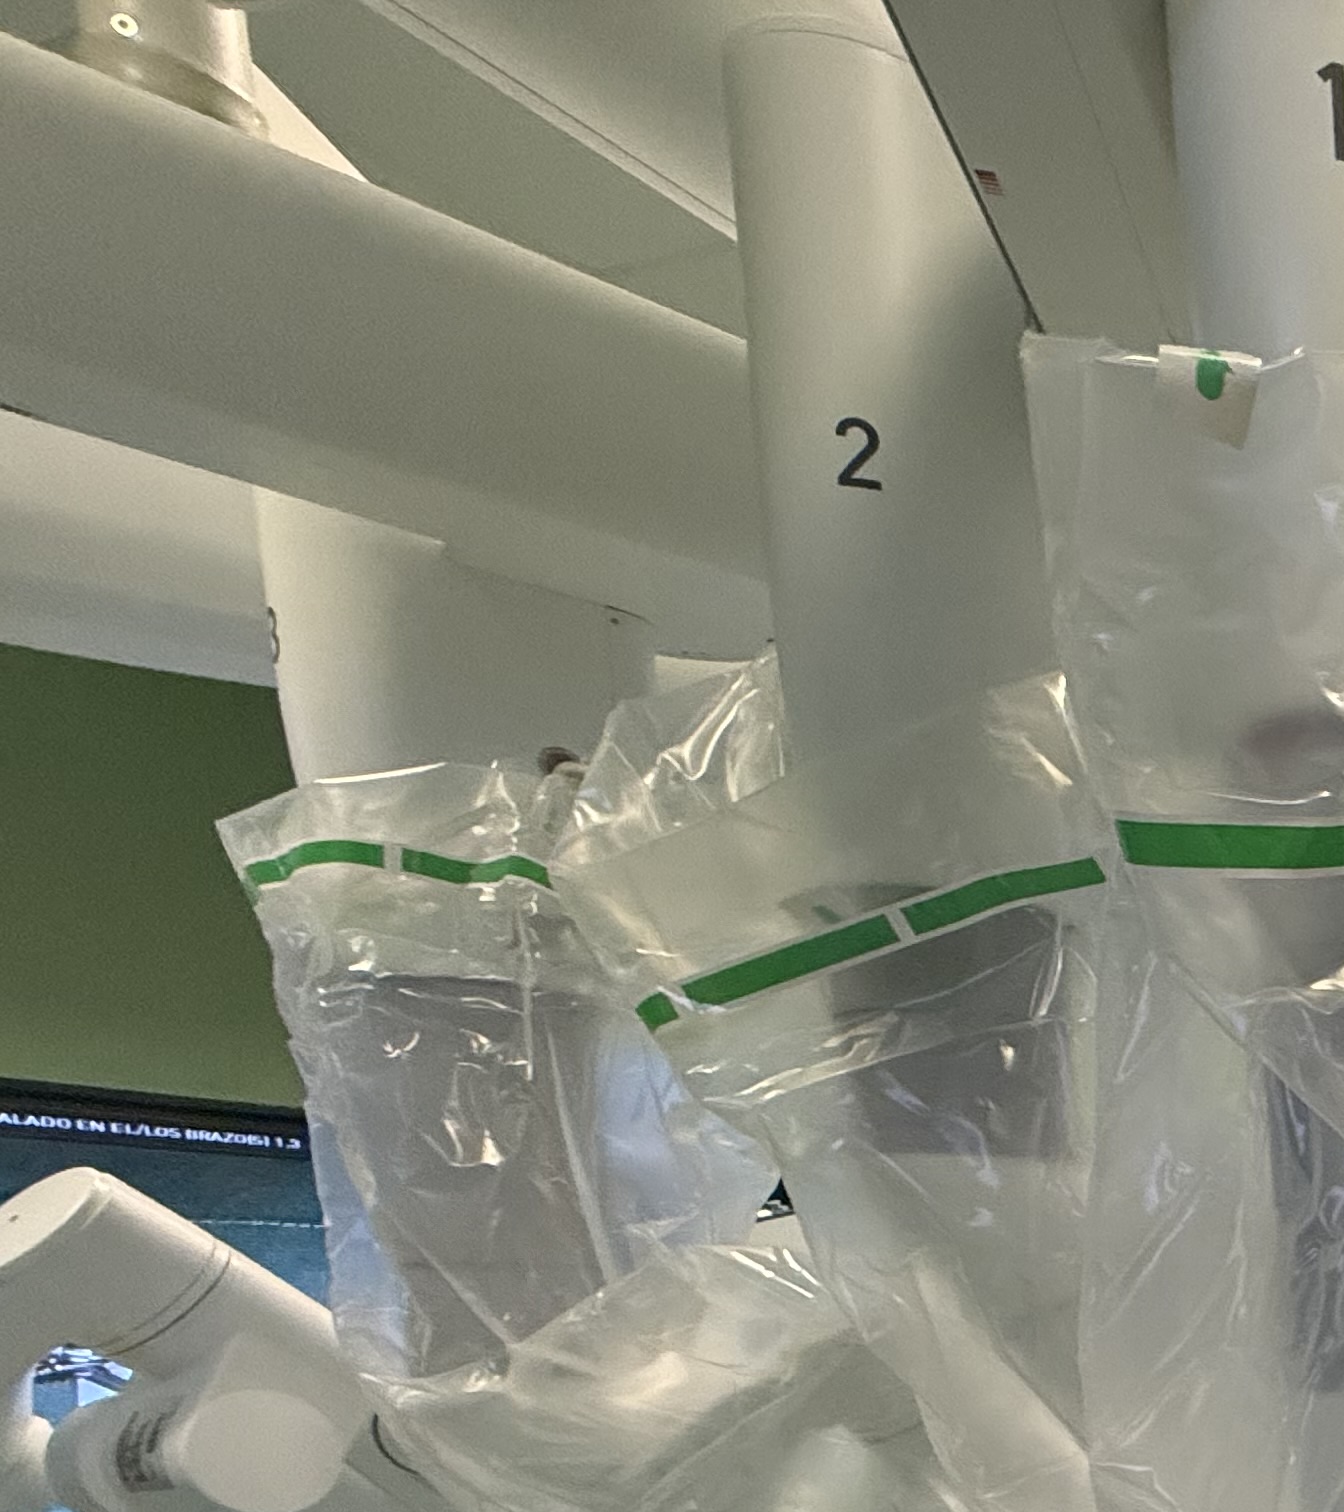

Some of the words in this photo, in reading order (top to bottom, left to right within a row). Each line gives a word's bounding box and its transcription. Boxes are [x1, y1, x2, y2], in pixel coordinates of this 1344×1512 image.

[835, 417, 883, 491] 2
[76, 1119, 106, 1133] EN
[110, 1121, 182, 1139] EL/LOS
